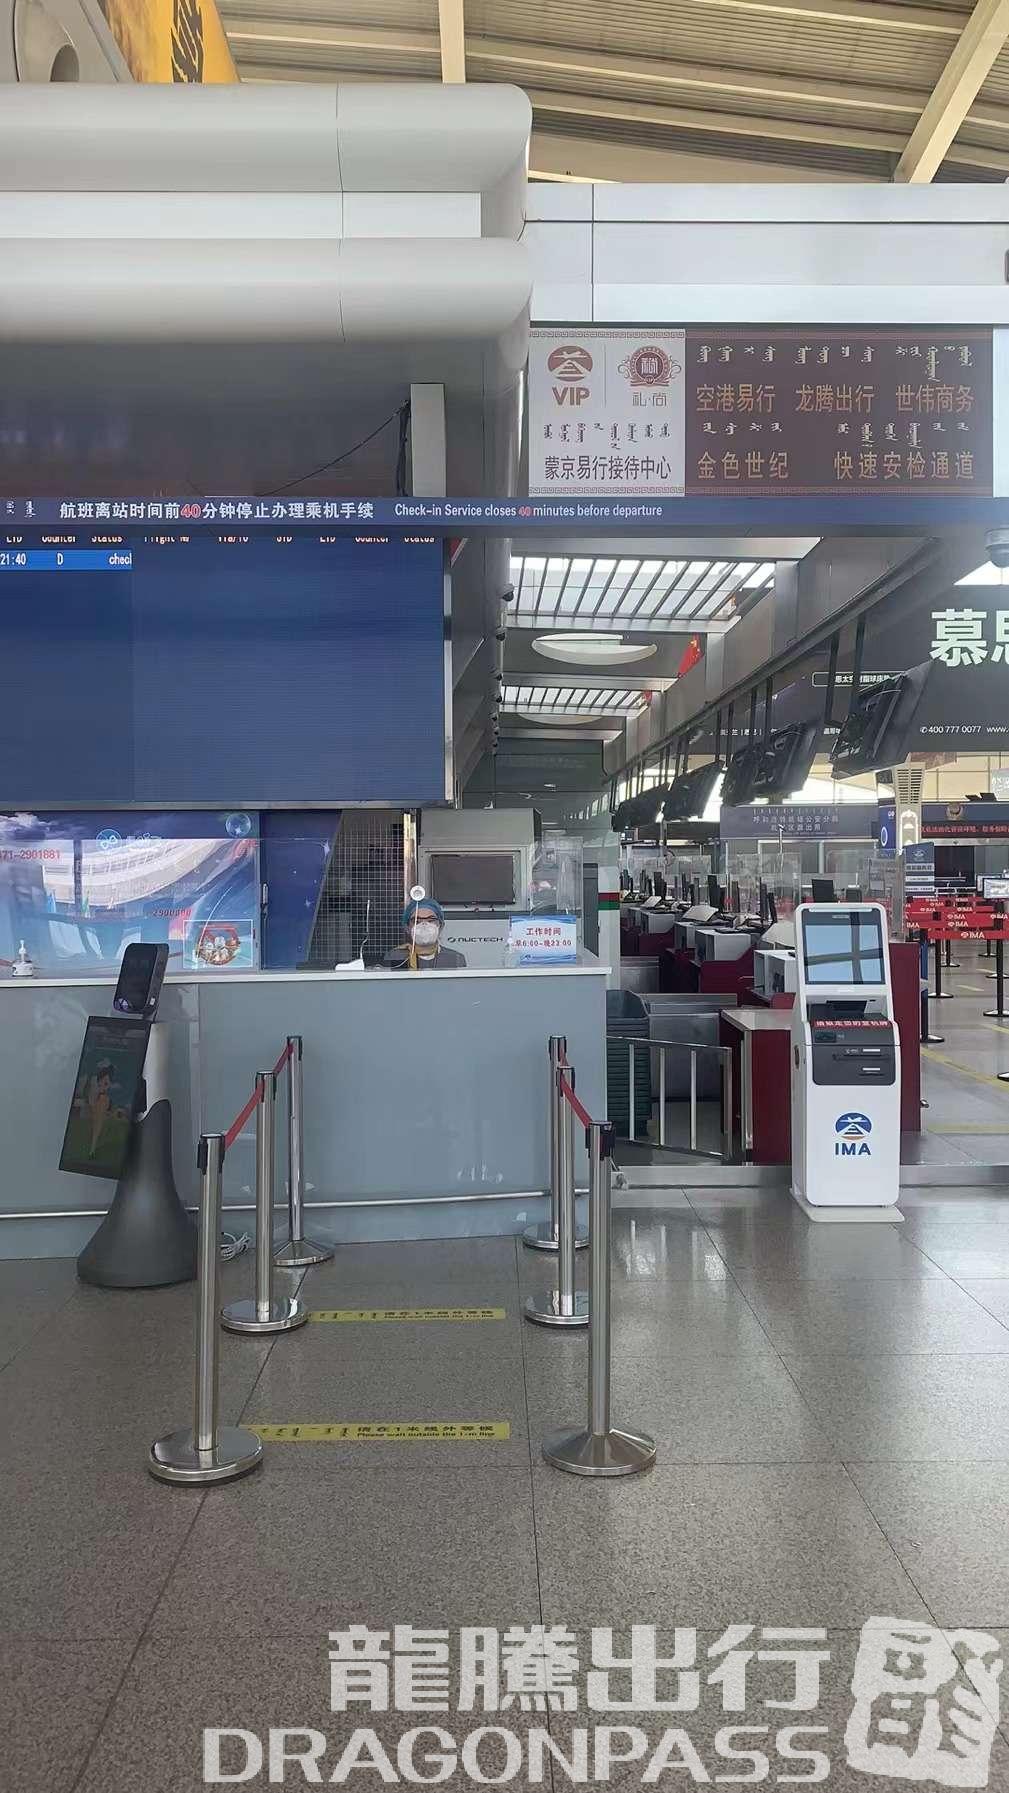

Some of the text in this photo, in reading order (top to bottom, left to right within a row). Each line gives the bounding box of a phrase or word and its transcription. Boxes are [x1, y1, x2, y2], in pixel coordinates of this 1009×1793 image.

[552, 387, 590, 406] VIP
[696, 384, 974, 413] 空港易行 龙腾出行 世伟商务
[545, 456, 671, 480] 蒙京易行接待中心
[698, 451, 974, 480] 金色世纪 快速安检通道
[60, 502, 374, 519] 航班离站时间前40分钟停止办理乘机手续
[395, 504, 442, 516] Check-in
[444, 504, 482, 516] Service
[484, 504, 516, 516] closes
[533, 504, 575, 516] minutes
[577, 504, 610, 516] before
[612, 504, 663, 518] departure
[0, 553, 26, 565] 21:40
[57, 553, 64, 565] D
[929, 726, 944, 734] 400
[945, 726, 960, 734] 777
[961, 726, 982, 734] 0077
[526, 928, 562, 936] 工作时间
[835, 1143, 871, 1156] IMA
